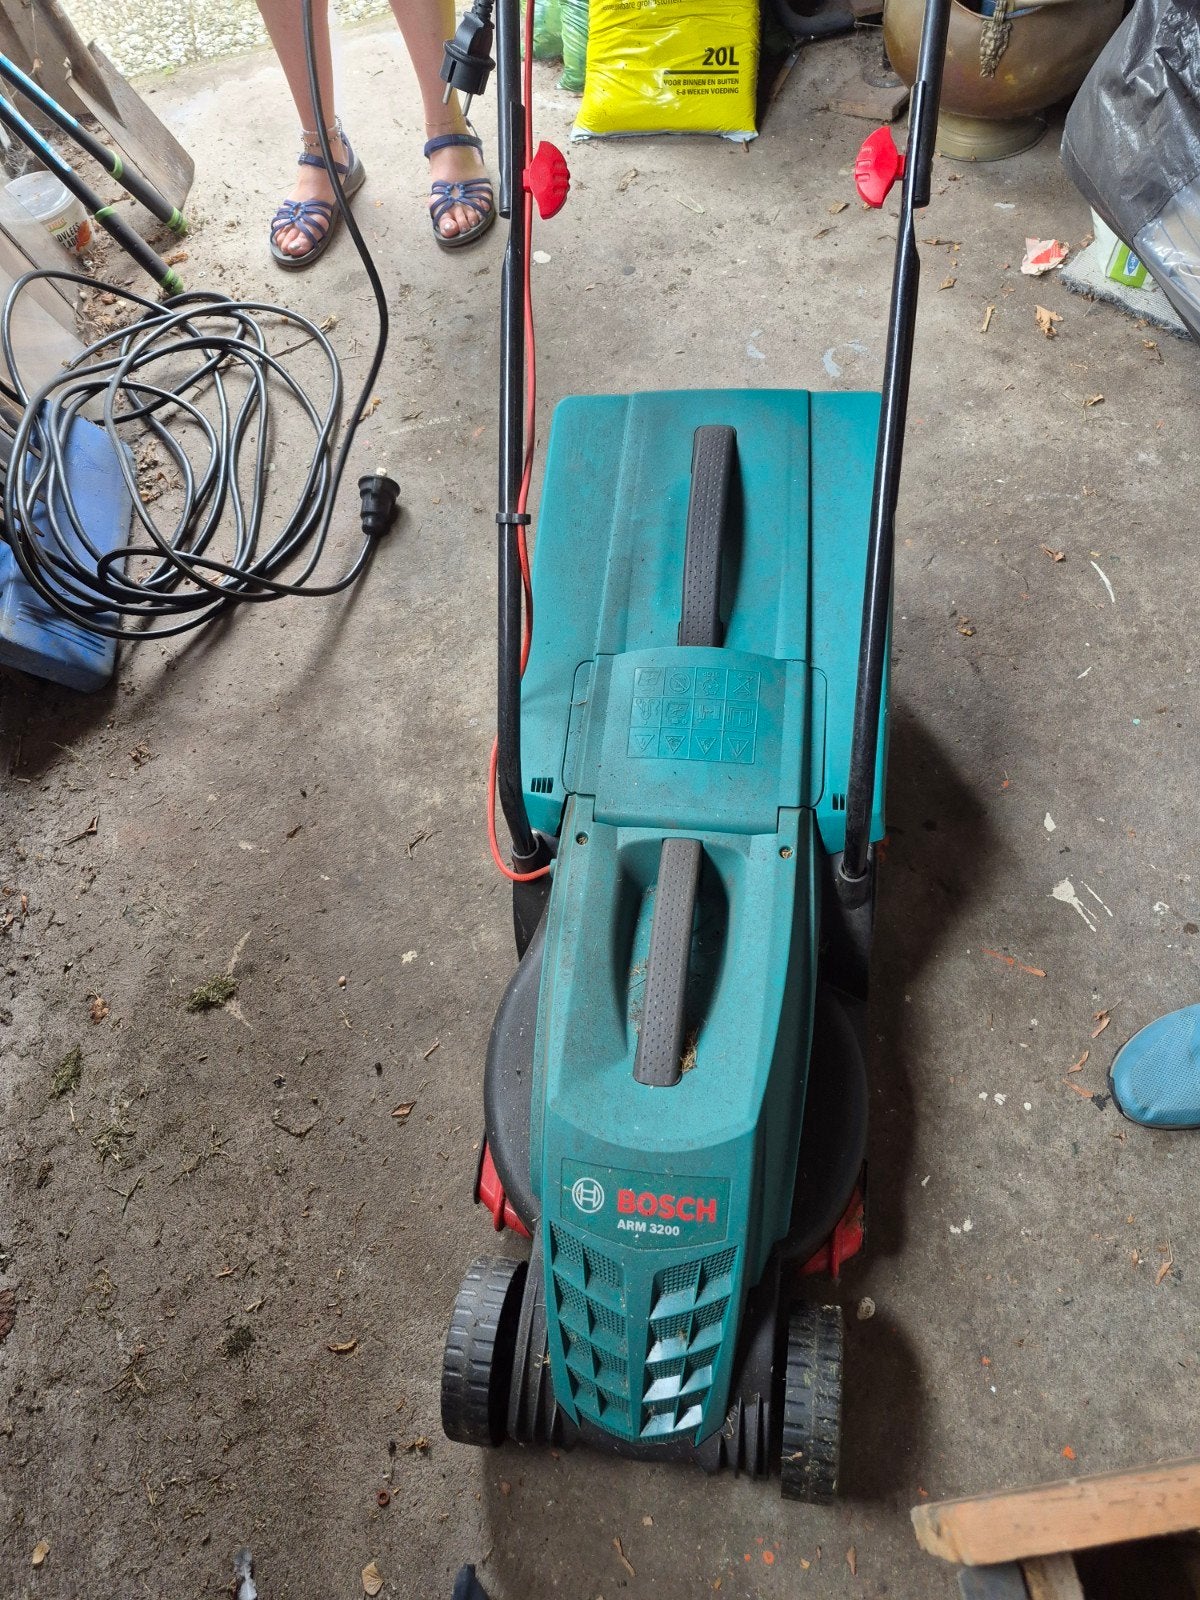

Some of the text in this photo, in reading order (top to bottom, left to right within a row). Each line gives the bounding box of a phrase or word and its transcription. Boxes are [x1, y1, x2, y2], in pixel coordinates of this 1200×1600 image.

[702, 46, 739, 66] 20L
[664, 79, 681, 87] VOOR
[708, 78, 715, 86] EN
[717, 77, 739, 85] BUITEN
[687, 87, 709, 95] WEKEN
[710, 86, 739, 94] VOEDING
[617, 1189, 717, 1223] BOSCH
[617, 1219, 680, 1236] ARM 3200
